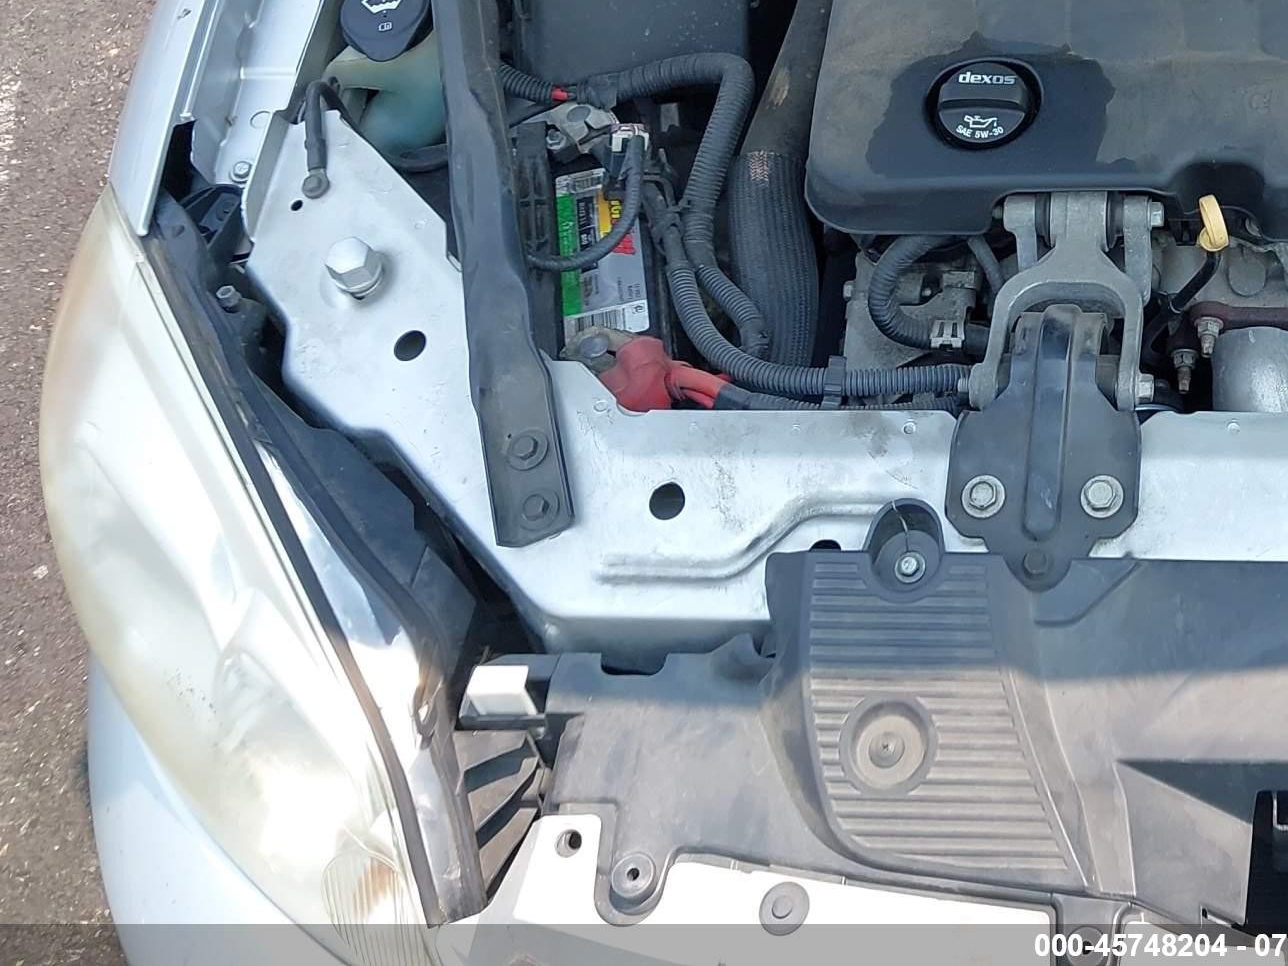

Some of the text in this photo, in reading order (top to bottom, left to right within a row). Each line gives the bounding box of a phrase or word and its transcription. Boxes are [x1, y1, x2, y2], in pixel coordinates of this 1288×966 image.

[958, 71, 1018, 85] dexos
[956, 125, 1004, 139] SAE 5W-30
